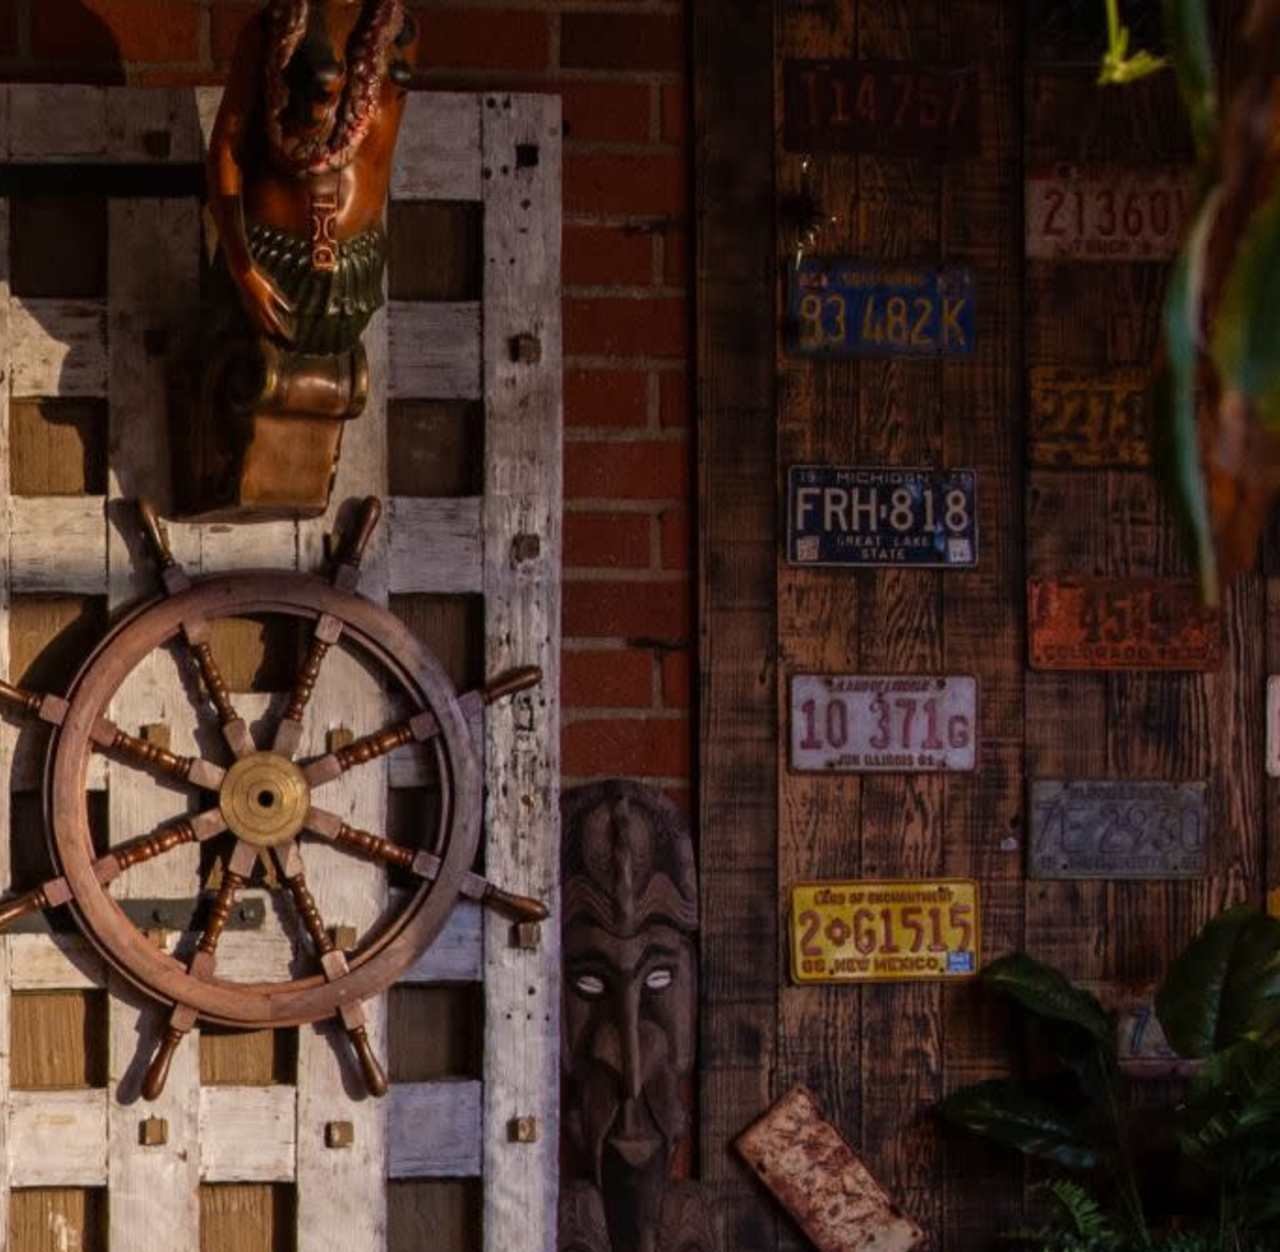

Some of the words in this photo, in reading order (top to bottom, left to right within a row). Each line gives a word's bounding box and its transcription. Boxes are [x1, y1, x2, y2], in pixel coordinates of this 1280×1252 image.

[860, 548, 905, 560] STATE
[834, 957, 870, 973] NEW
[873, 956, 939, 972] MEXICO
